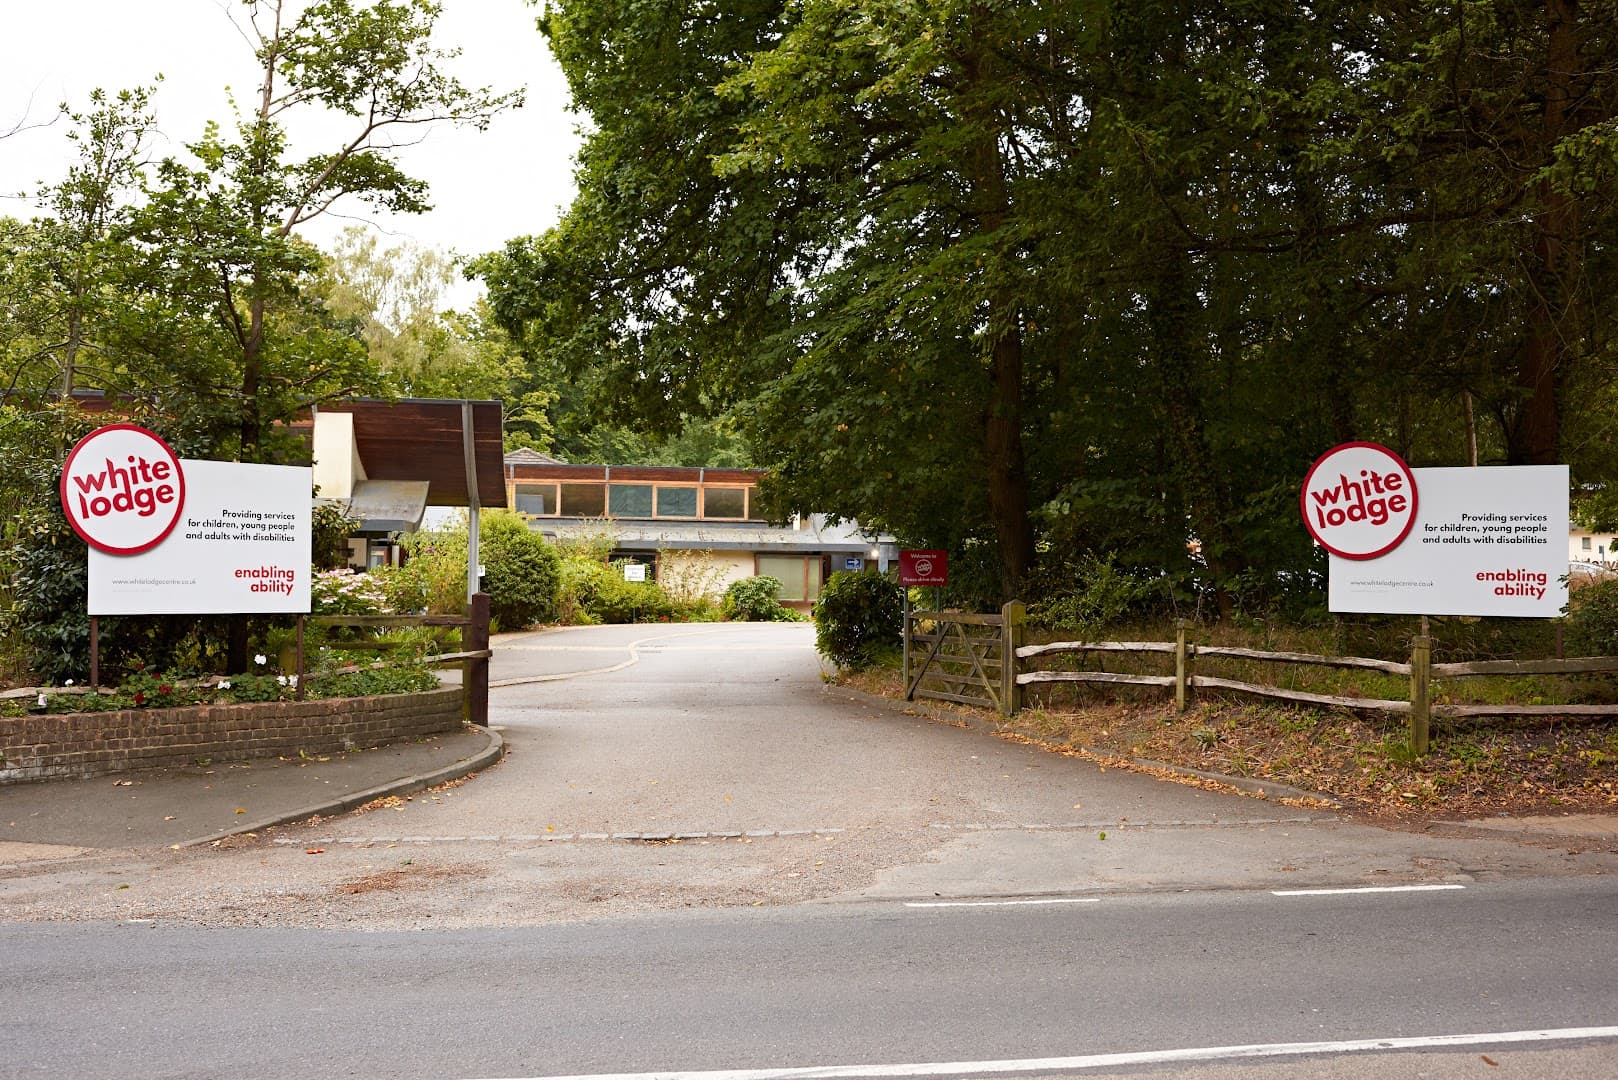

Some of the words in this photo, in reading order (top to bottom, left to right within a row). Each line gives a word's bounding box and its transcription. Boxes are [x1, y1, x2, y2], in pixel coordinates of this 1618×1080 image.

[73, 455, 171, 494] white
[1311, 470, 1402, 506] white
[78, 484, 175, 520] lodge
[222, 509, 262, 521] Providing
[264, 512, 295, 521] services
[1315, 493, 1407, 529] lodge
[1461, 513, 1508, 524] Providing
[1509, 513, 1547, 522] services
[188, 519, 201, 528] for
[202, 519, 239, 530] children,
[240, 522, 266, 531] young
[268, 521, 295, 532] people
[1424, 524, 1438, 532] for
[1439, 524, 1480, 534] children,
[1482, 526, 1513, 535] young
[1514, 524, 1547, 535] people
[186, 531, 203, 540] and
[204, 531, 231, 541] adults
[232, 531, 251, 541] with
[252, 532, 295, 542] disabilities
[1422, 535, 1441, 544] and
[1442, 535, 1471, 544] adults
[1473, 535, 1495, 544] with
[1496, 535, 1547, 544] disabilities
[234, 566, 295, 582] enabling
[1475, 568, 1548, 586] enabling
[250, 580, 294, 596] ability
[1494, 583, 1547, 600] ability
